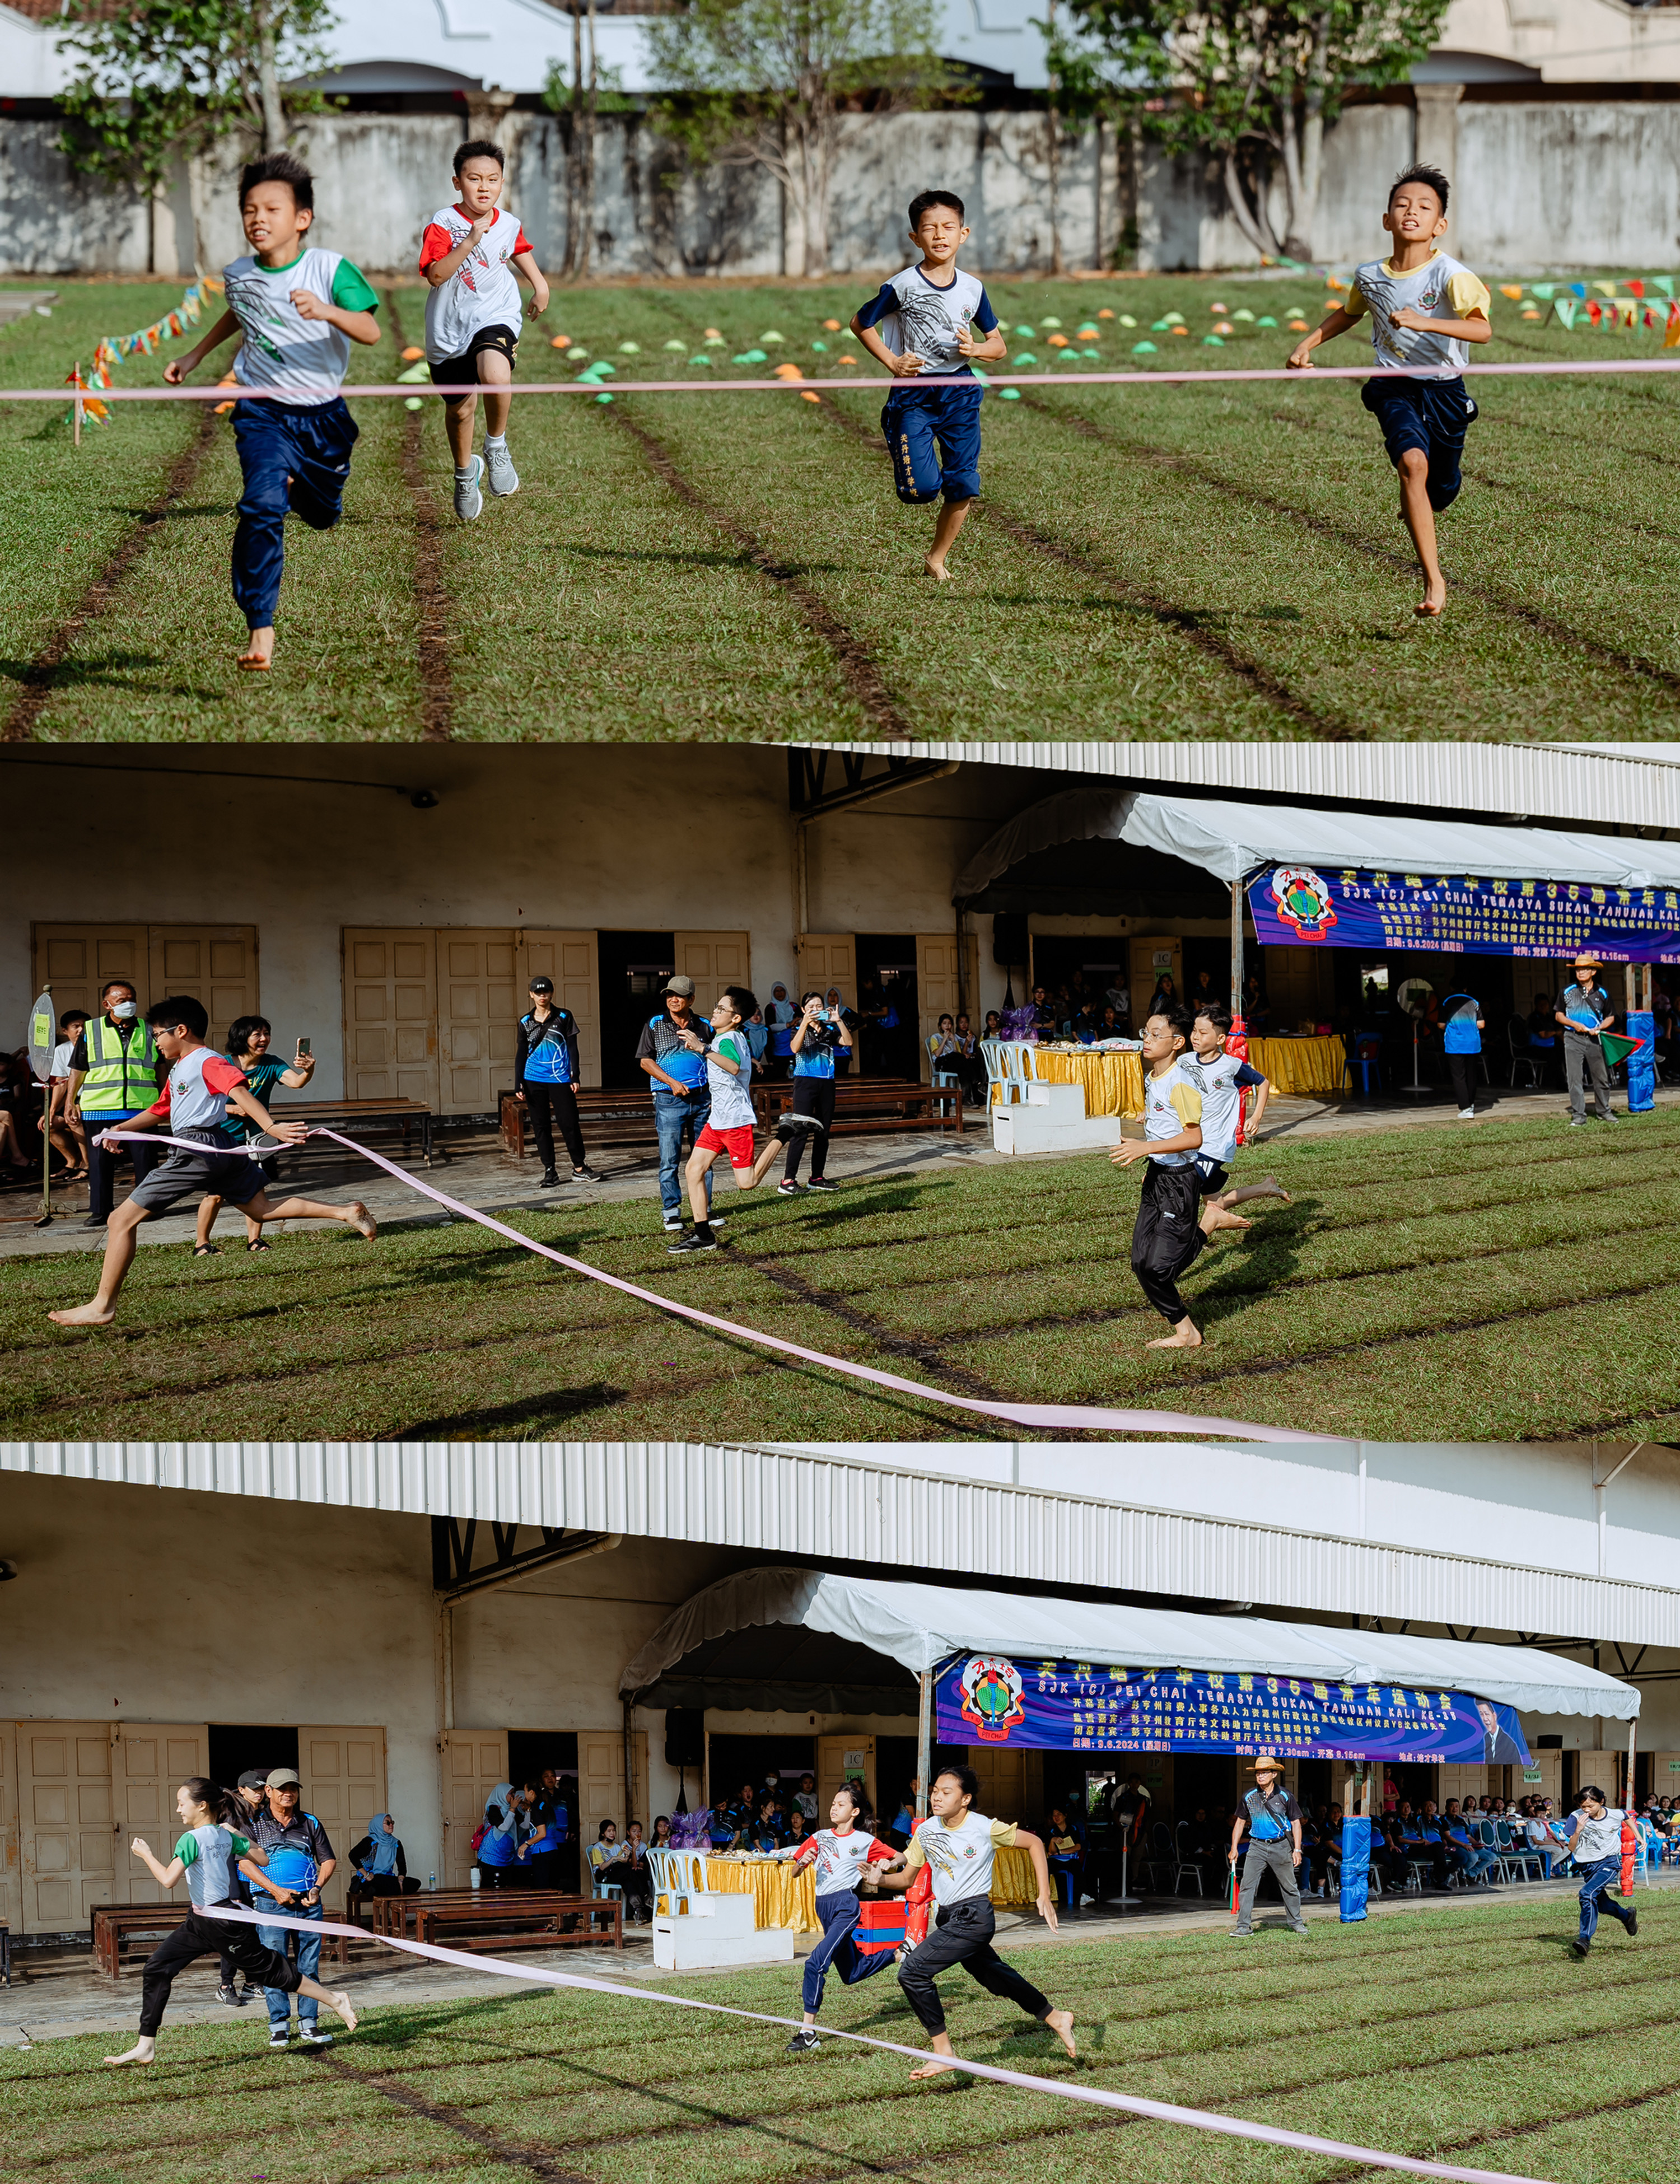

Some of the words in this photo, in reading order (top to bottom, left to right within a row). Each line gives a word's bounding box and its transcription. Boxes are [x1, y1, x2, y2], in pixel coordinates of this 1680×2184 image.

[1343, 886, 1371, 899] SJK
[1381, 889, 1404, 900] (C)
[1413, 890, 1439, 902] PEI
[1444, 891, 1473, 904] CHAI
[1481, 894, 1542, 911] TEMASYA
[1549, 901, 1590, 914] SUKAN
[1598, 906, 1654, 920] TAHUNAN
[1038, 1680, 1068, 1694] SJK
[1080, 1683, 1105, 1696] (C)
[1115, 1685, 1141, 1697] PEI
[1150, 1686, 1187, 1700] CHAI
[1197, 1689, 1264, 1706] TEMASYA
[1272, 1696, 1315, 1711] SUKAN
[1323, 1702, 1382, 1717] TAHUNAN
[1388, 1707, 1416, 1719] KALI
[1421, 1709, 1457, 1721] KE-35
[1097, 1739, 1140, 1750] 9.6.2024
[849, 1754, 861, 1764] 1C
[1278, 1747, 1310, 1757] 7.30am
[1336, 1750, 1366, 1760] 8.15am
